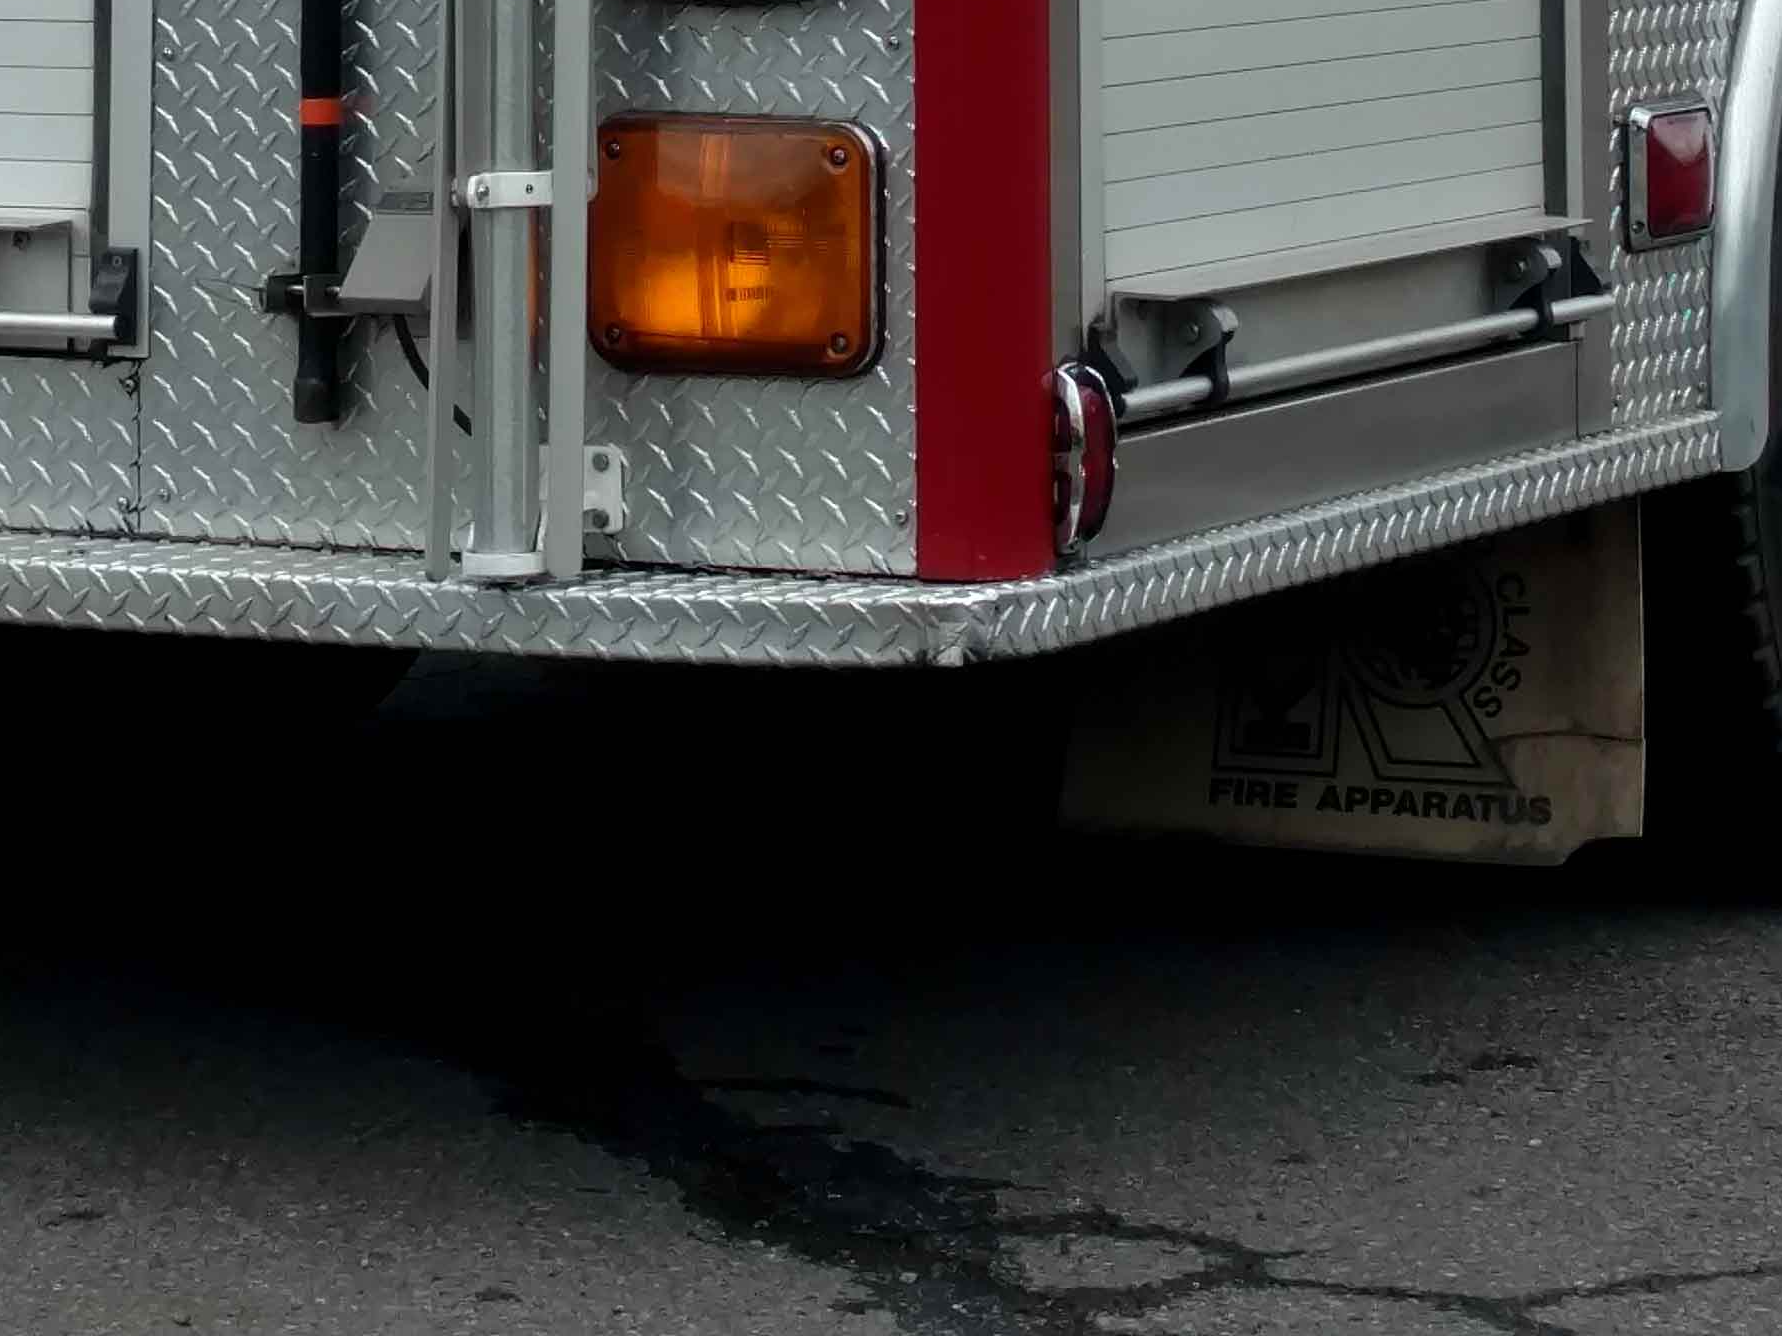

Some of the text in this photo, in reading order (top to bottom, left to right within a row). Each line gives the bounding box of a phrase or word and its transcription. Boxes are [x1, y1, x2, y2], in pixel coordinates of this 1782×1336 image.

[1474, 573, 1530, 717] CLASS
[1209, 776, 1552, 824] FIRE APPARATUS
